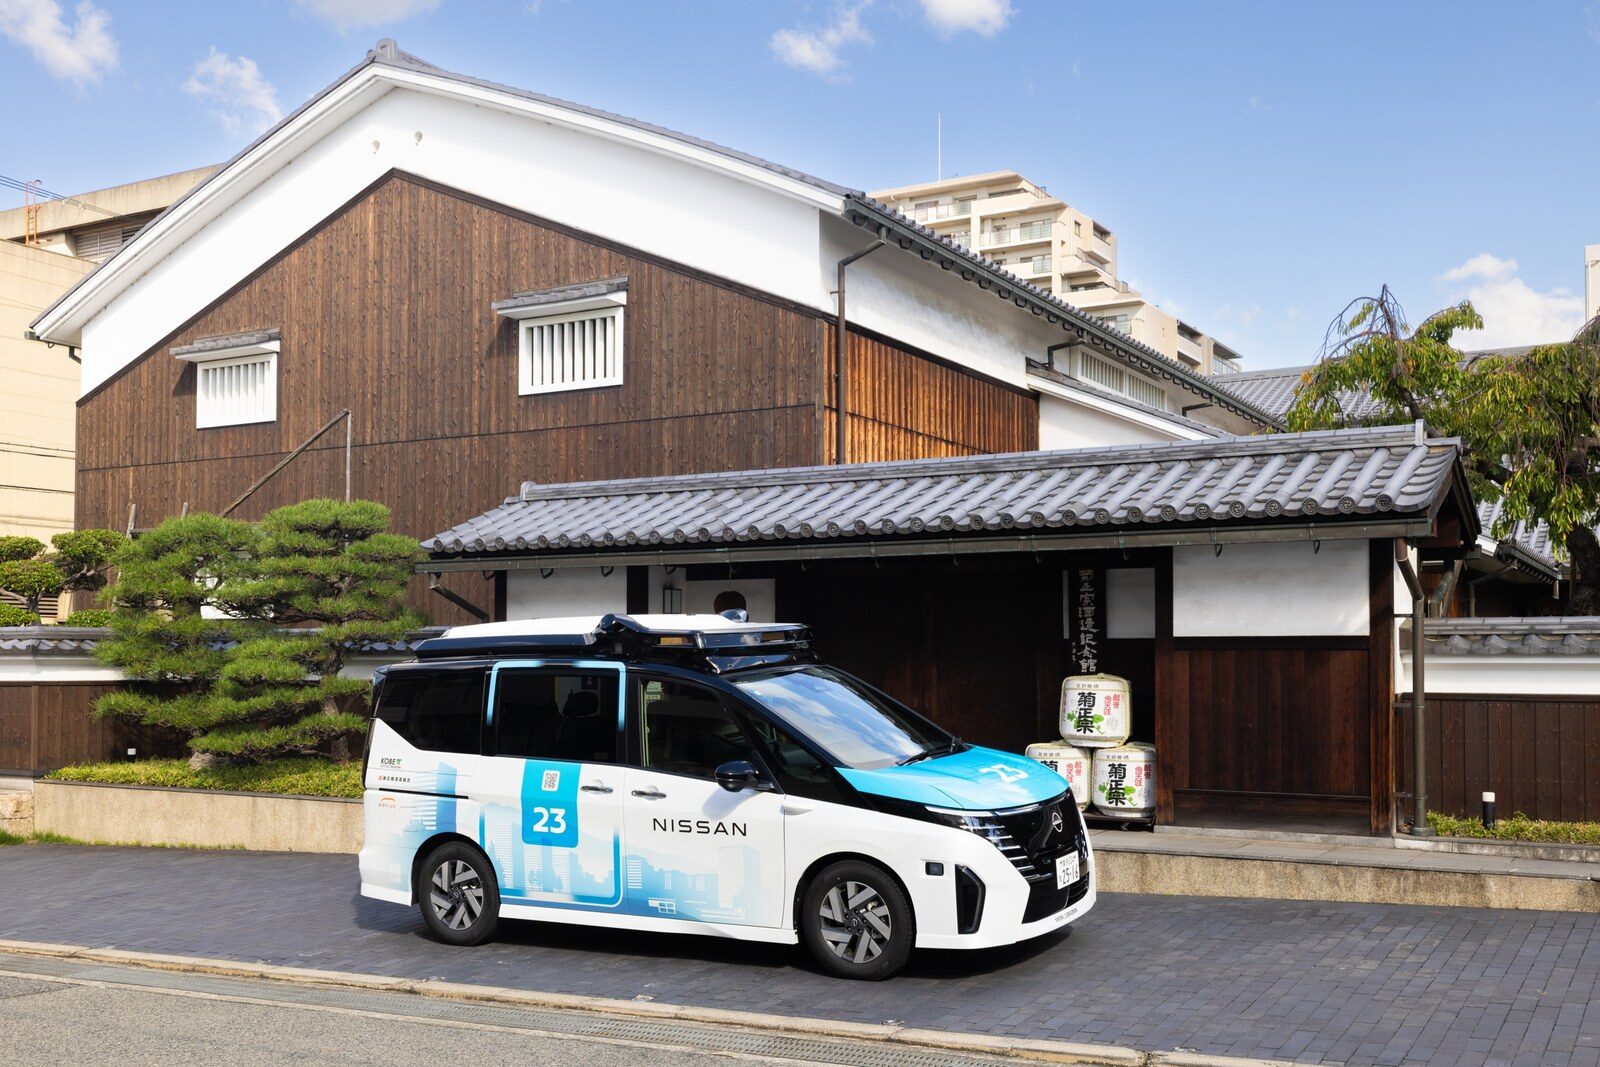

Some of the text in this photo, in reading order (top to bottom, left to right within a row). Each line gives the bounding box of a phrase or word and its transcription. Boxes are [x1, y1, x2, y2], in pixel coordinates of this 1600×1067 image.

[1077, 692, 1096, 734] 菊正宗
[1108, 763, 1127, 806] 菊正宗
[533, 807, 567, 834] 23
[653, 818, 747, 836] NISSAN
